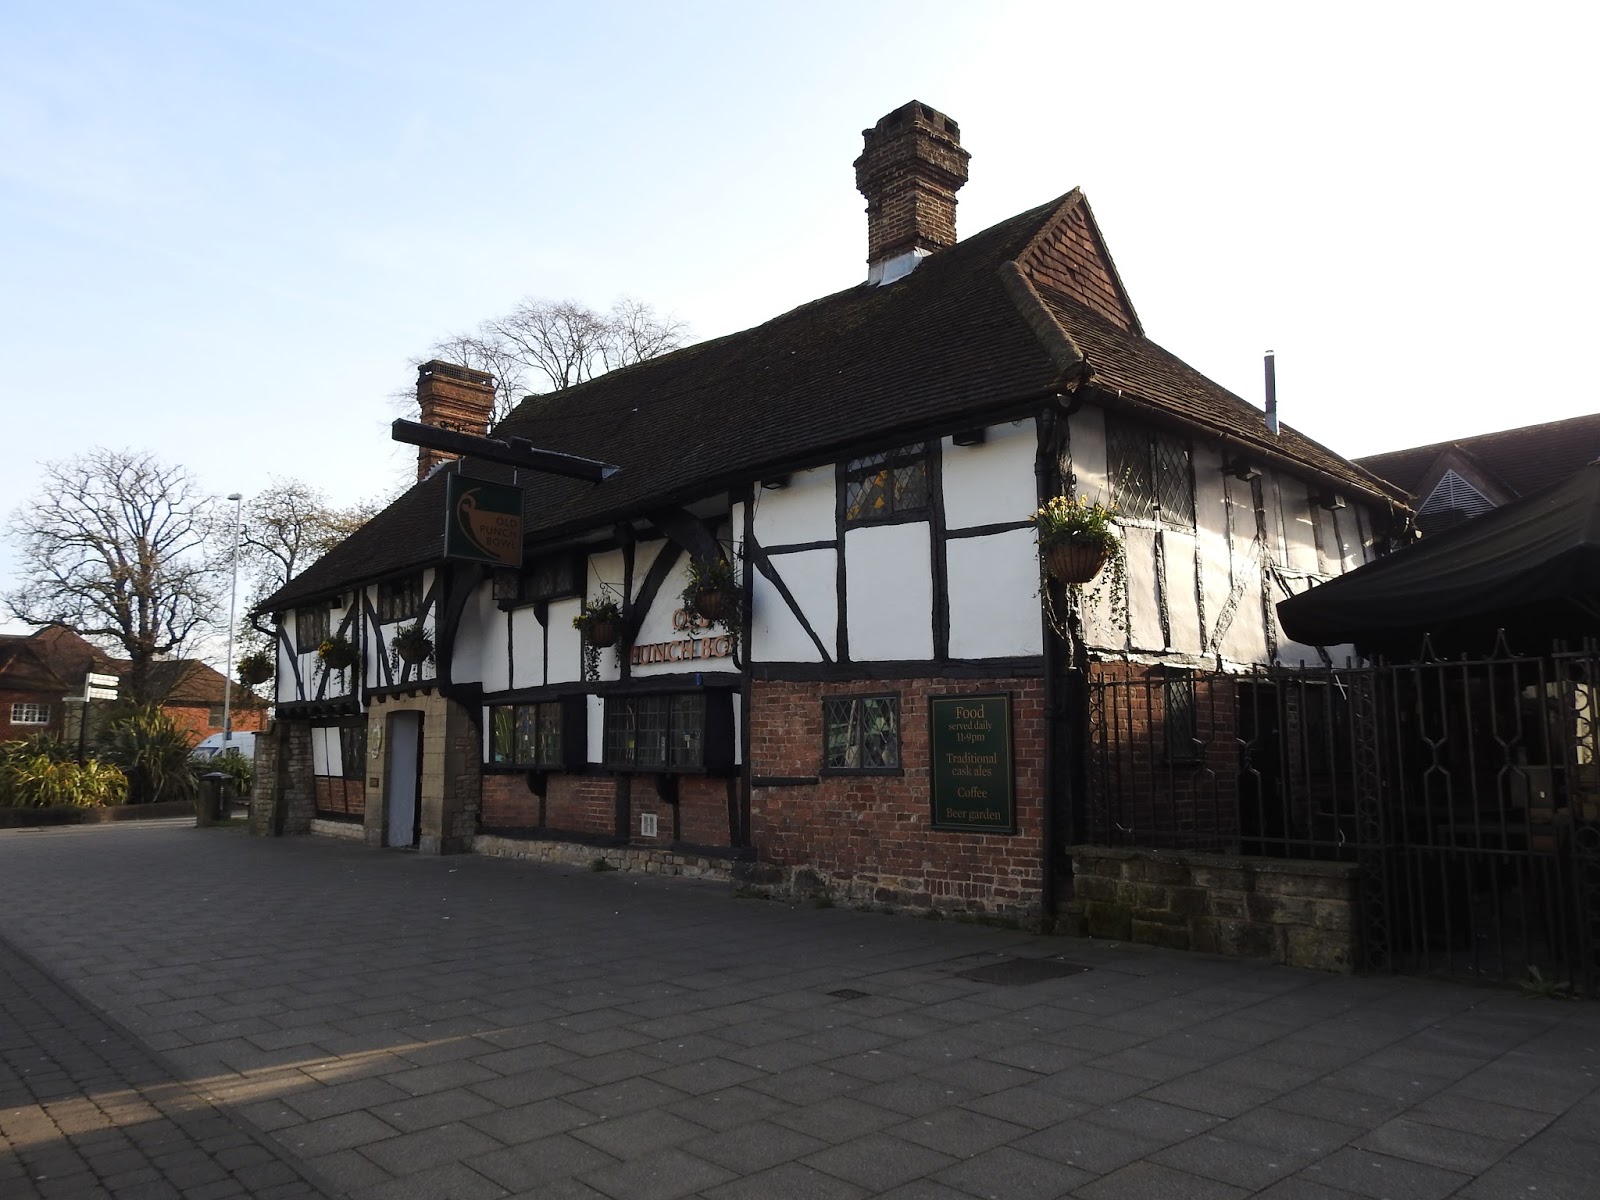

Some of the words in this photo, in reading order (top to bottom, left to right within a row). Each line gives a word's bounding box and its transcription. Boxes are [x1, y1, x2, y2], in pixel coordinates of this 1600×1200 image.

[496, 516, 518, 528] OLD
[480, 525, 516, 539] PUNCH
[486, 537, 515, 549] BOWL
[701, 635, 735, 660] BO
[955, 704, 985, 719] Food
[948, 721, 973, 731] served
[973, 720, 993, 732] daily
[946, 752, 997, 764] Traditional
[951, 765, 972, 776] cask
[973, 765, 992, 777] ales
[957, 786, 988, 798] Coffee
[946, 807, 967, 819] Beer
[968, 808, 1001, 821] garden
